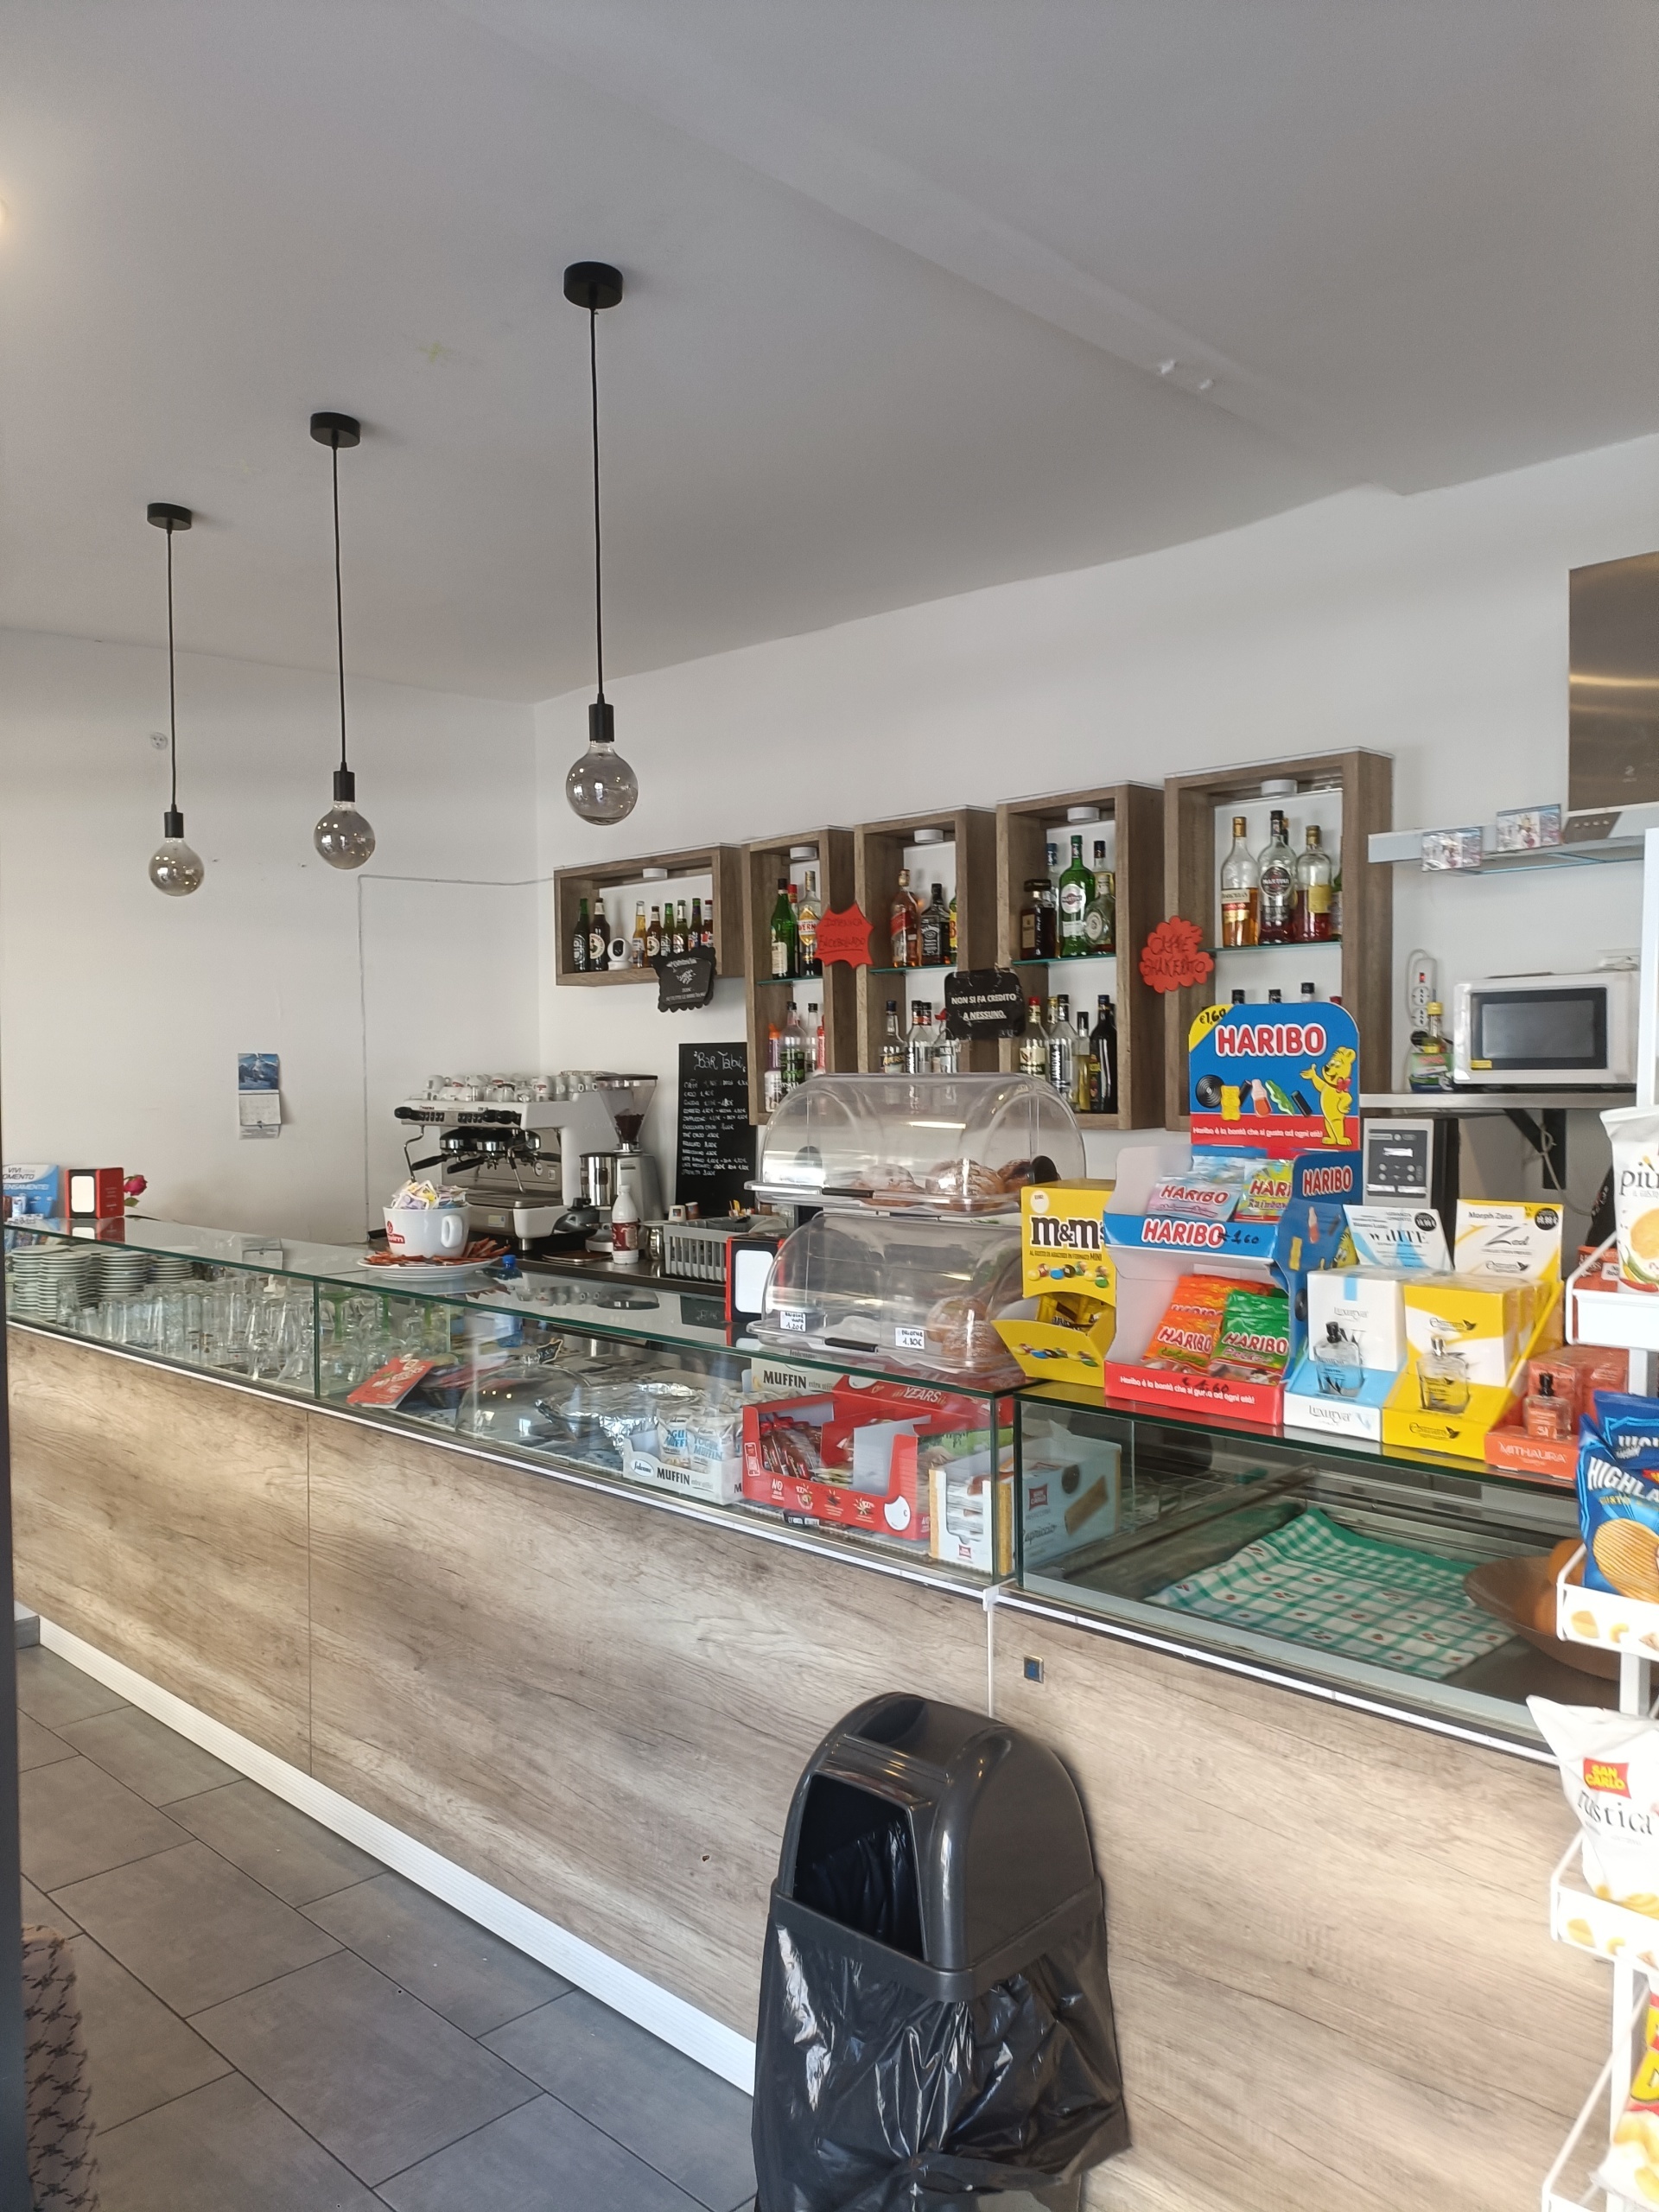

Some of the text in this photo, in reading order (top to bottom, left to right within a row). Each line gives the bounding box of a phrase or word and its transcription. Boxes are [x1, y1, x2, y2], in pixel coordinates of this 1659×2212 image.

[951, 995, 968, 1005] NON
[977, 995, 987, 1003] FA
[987, 993, 1017, 1002] CREDITO
[963, 1012, 969, 1020] A
[1216, 1025, 1325, 1056] HARIBO
[1192, 1126, 1214, 1135] Haribo
[1266, 1128, 1284, 1138] gusta
[1294, 1129, 1309, 1139] ogni
[1249, 1179, 1292, 1198] HARI
[1302, 1166, 1353, 1197] HARIBO
[1160, 1185, 1229, 1205] HARIBO
[1141, 1218, 1226, 1248] HARIBO
[1090, 1253, 1103, 1262] MINI
[1222, 1332, 1289, 1356] HARIBO
[763, 1370, 807, 1389] MUFFIN
[903, 1387, 942, 1403] YEARS
[1120, 1376, 1141, 1387] Haribo
[1174, 1383, 1187, 1394] che
[1224, 1392, 1240, 1403] ogni
[694, 1446, 723, 1461] MUFFIN
[657, 1467, 690, 1485] MUFFIN
[771, 1478, 784, 1491] NO
[1592, 1764, 1618, 1778] SAN
[1585, 1772, 1626, 1790] CARLO
